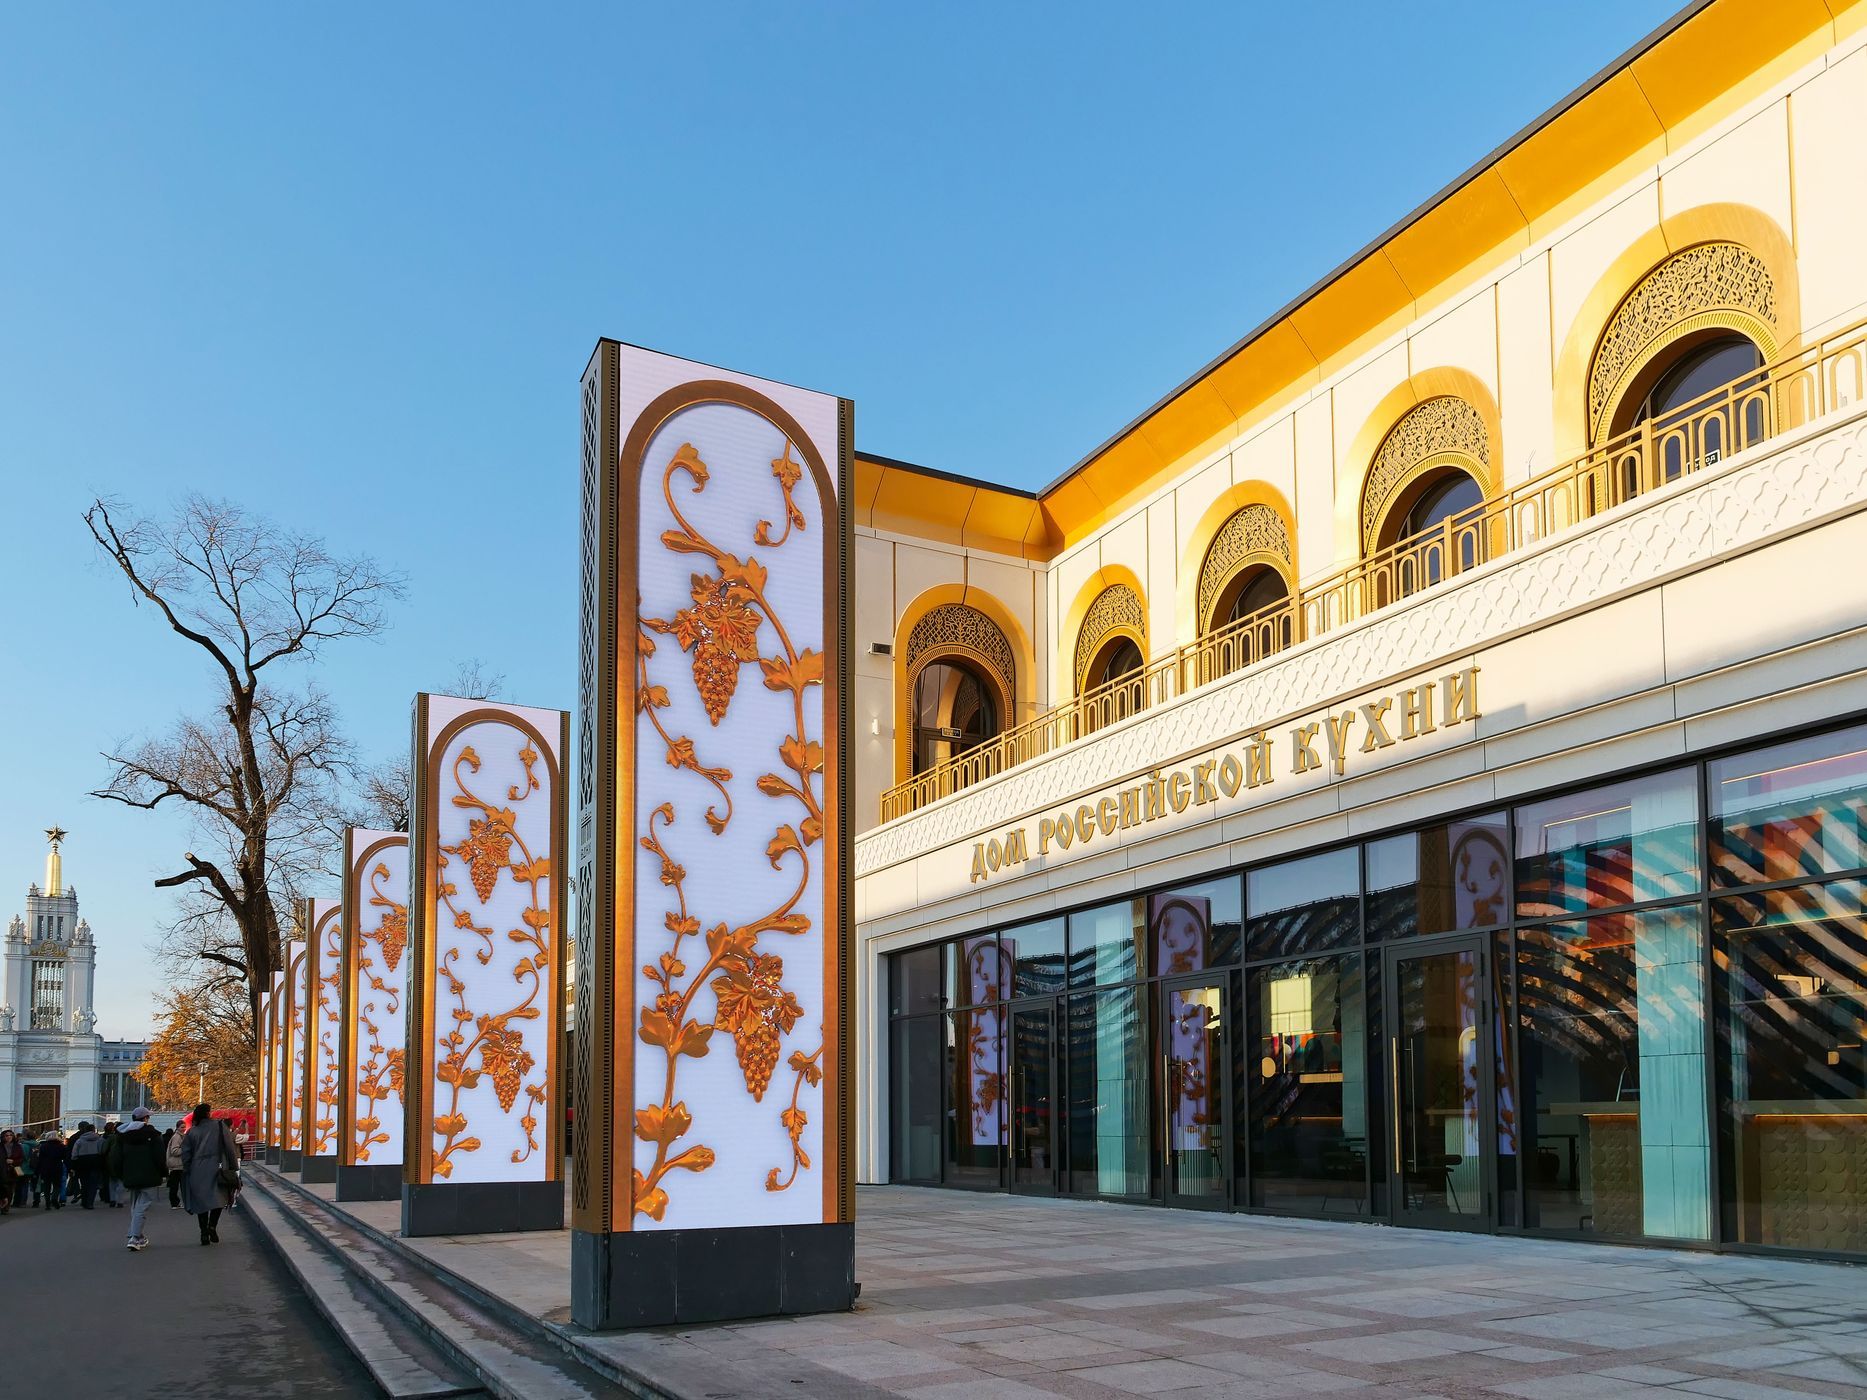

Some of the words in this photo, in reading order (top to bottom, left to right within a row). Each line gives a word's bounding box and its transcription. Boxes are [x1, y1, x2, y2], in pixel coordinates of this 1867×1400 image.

[970, 828, 1029, 884] ДОМ
[1037, 730, 1275, 855] РОССИЙСКОЙ
[1290, 666, 1482, 776] КУХНИ
